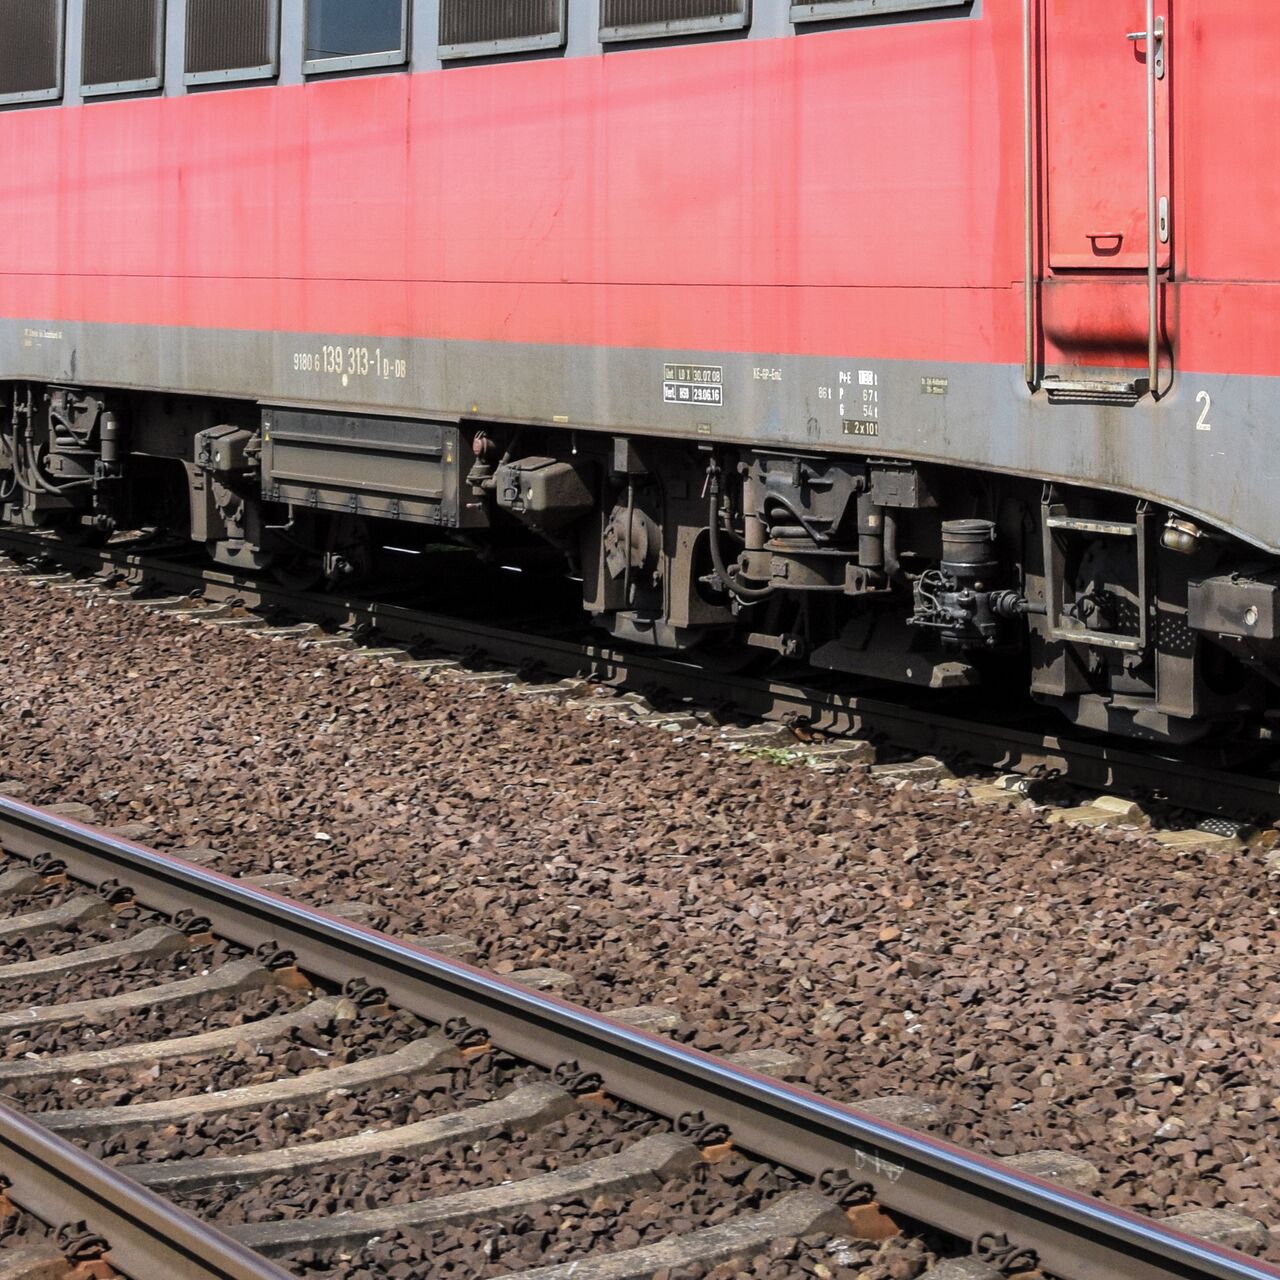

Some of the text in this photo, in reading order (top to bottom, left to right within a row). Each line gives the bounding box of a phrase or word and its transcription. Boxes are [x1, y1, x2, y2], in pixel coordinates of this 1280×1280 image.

[322, 345, 343, 374] 139
[347, 347, 381, 376] 313-1
[839, 388, 844, 400] P
[1195, 390, 1211, 431] 2
